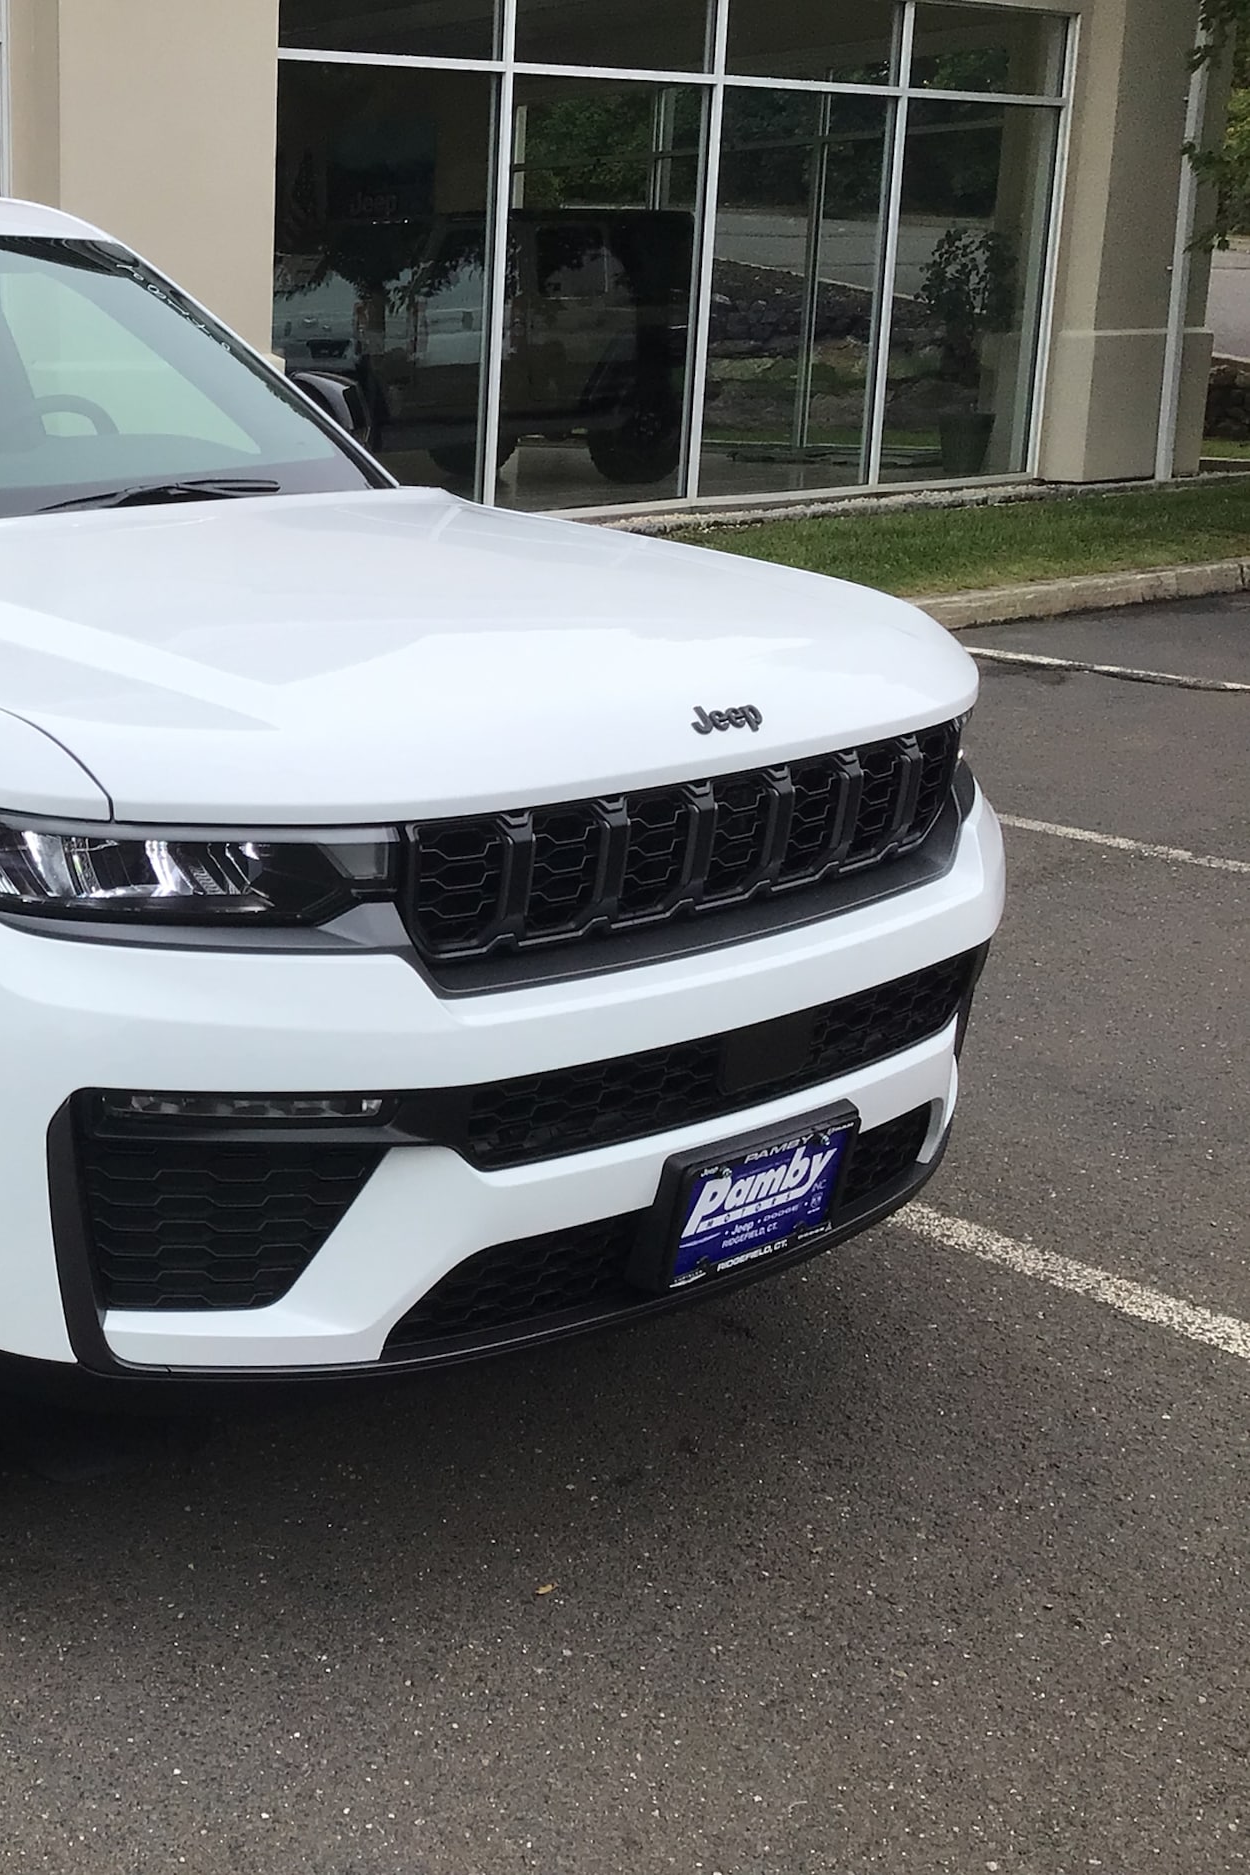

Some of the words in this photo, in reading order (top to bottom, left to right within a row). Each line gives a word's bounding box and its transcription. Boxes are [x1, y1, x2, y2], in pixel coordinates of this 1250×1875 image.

[691, 704, 763, 735] Jeep
[743, 1133, 815, 1164] PAMBY
[700, 1165, 719, 1178] Jeep
[681, 1145, 838, 1239] Pamby
[731, 1220, 755, 1236] Jeep
[763, 1203, 800, 1221] DODGE
